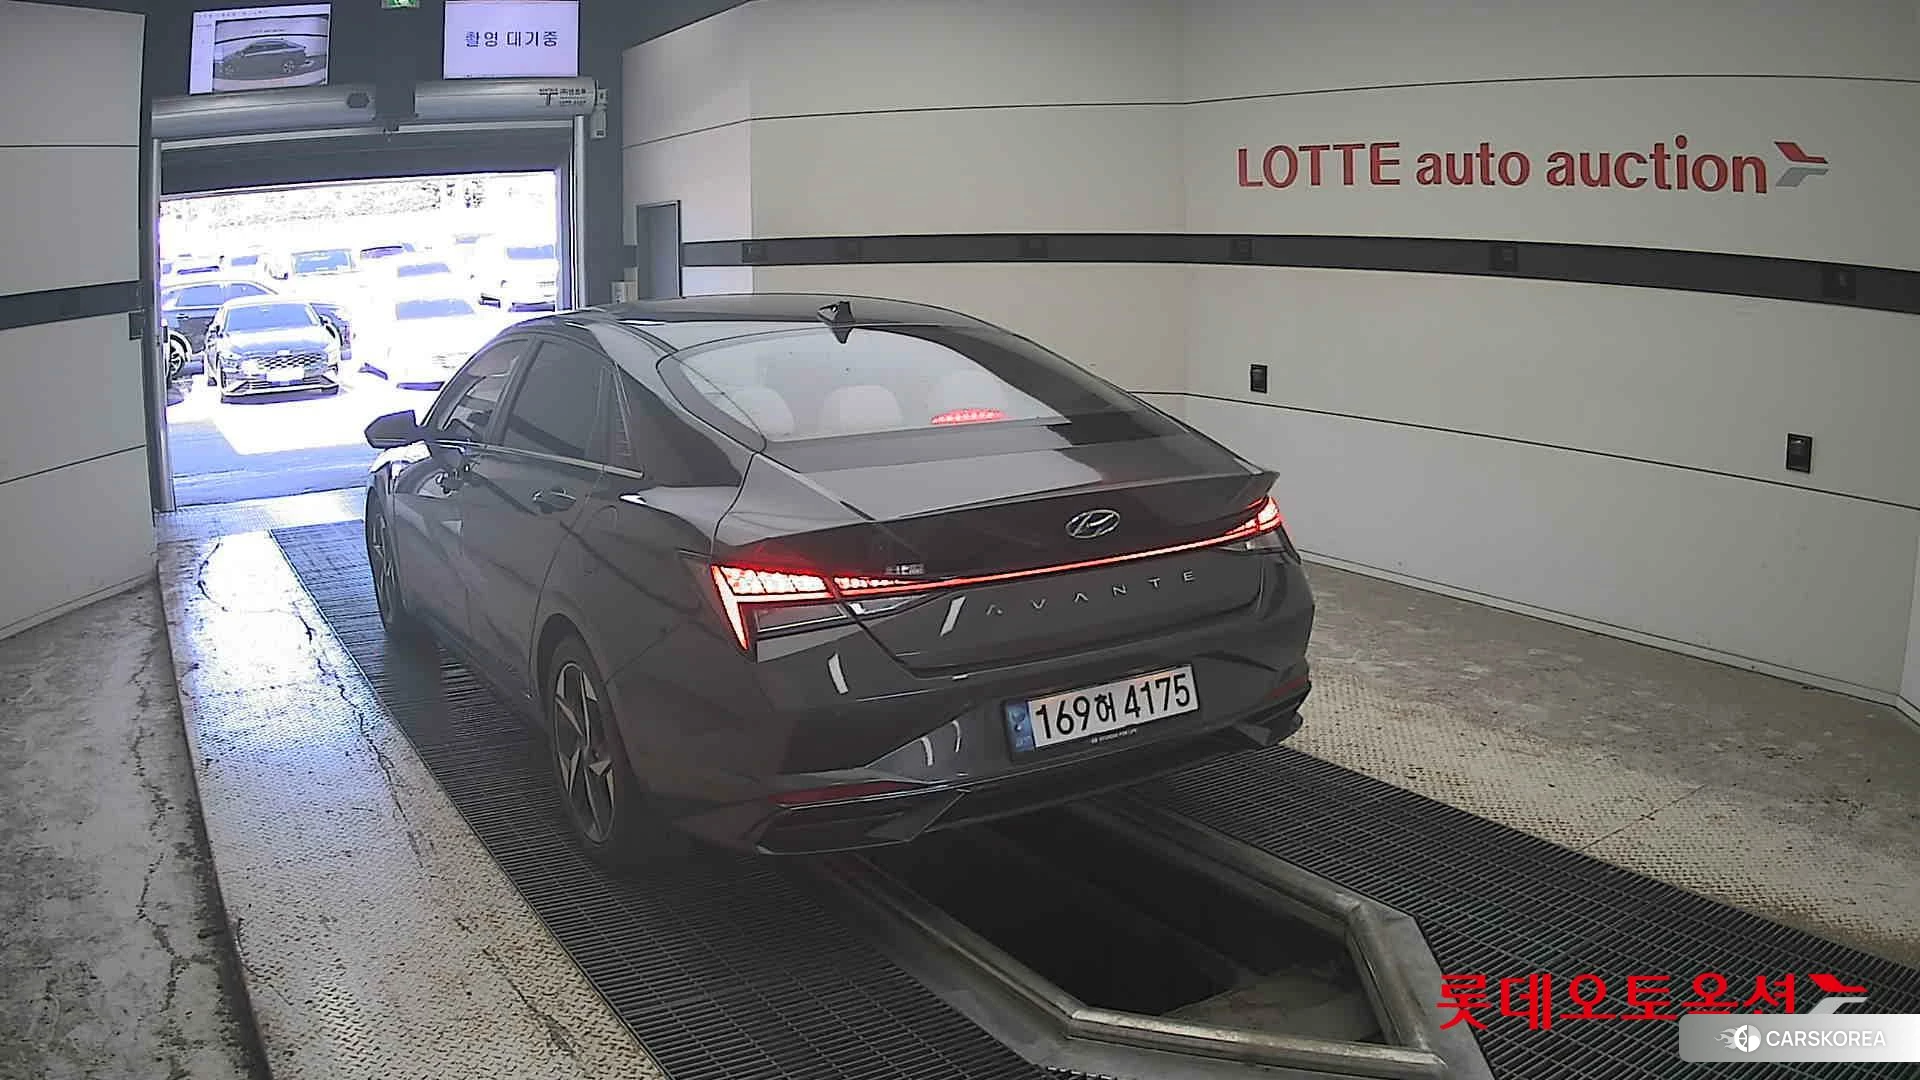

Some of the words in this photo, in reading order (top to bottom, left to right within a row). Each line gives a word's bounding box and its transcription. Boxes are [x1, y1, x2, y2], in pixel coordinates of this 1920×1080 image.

[1238, 142, 1400, 188] LOTTE
[1416, 142, 1530, 187] auto
[1546, 135, 1767, 194] auction
[986, 570, 1195, 616] AVANTE
[1036, 692, 1117, 739] 169허
[1125, 673, 1190, 718] 4175
